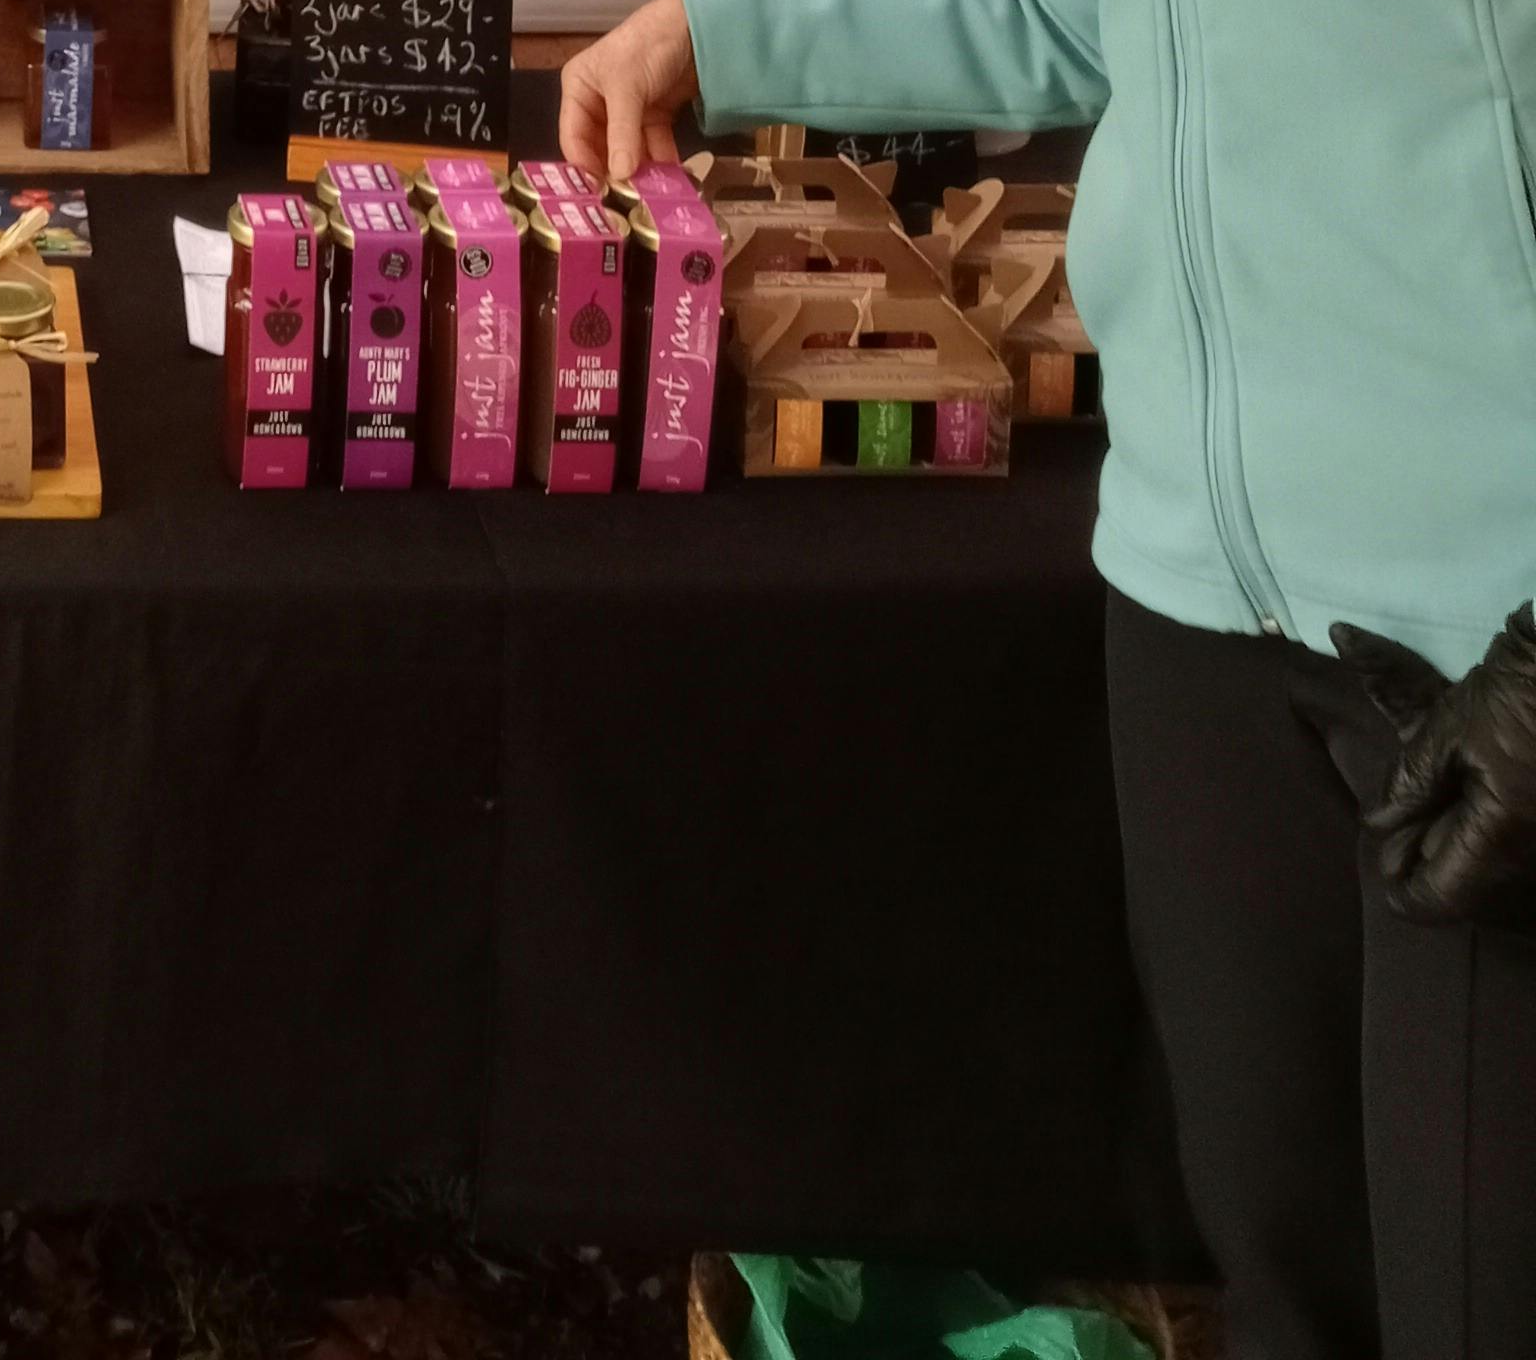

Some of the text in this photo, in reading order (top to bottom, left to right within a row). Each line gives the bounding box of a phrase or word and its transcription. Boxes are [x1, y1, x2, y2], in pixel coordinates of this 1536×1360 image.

[304, 34, 326, 62] 3
[62, 41, 80, 137] marmalade
[301, 88, 406, 116] EFTPOS
[318, 112, 369, 140] FEE
[464, 288, 515, 374] jam
[658, 289, 710, 376] jam
[358, 346, 382, 360] AUNTY
[576, 355, 601, 369] FRESH
[255, 357, 308, 373] STRAWBERRY
[366, 360, 403, 384] PLUM
[266, 372, 295, 395] JAM
[368, 382, 398, 406] JAM
[573, 388, 601, 411] JAM
[268, 410, 289, 423] JUST
[371, 413, 392, 426] JUST
[460, 375, 512, 449] just
[575, 415, 596, 428] JUST
[651, 373, 704, 458] just
[253, 422, 303, 436] HOMEGROWN
[356, 425, 406, 439] HOMEGROWN
[560, 428, 610, 441] HOMEGROWN
